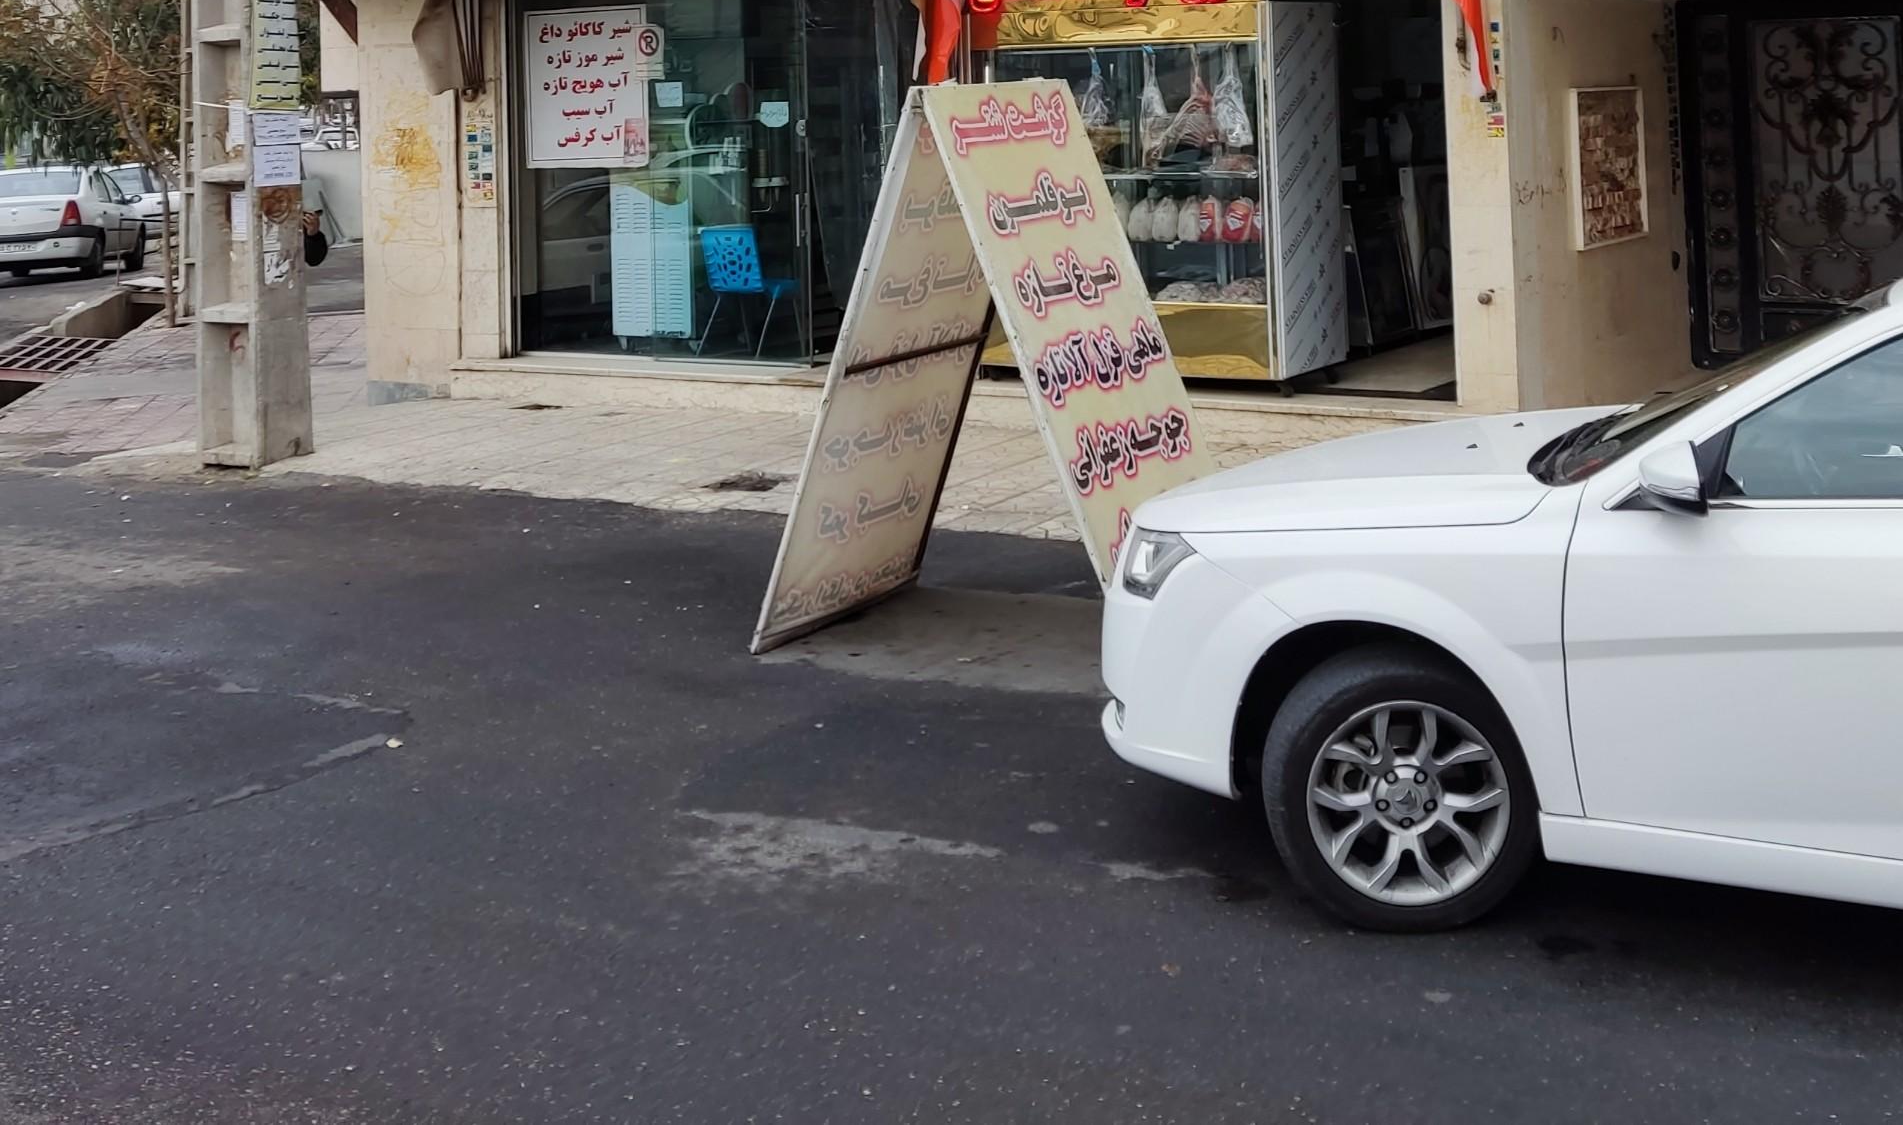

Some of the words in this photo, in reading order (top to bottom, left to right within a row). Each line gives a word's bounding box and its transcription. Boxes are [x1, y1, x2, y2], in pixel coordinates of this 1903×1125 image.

[538, 23, 563, 43] داغ
[565, 21, 605, 42] کاکائو
[608, 19, 632, 40] شیر
[546, 49, 572, 69] تازه
[575, 52, 598, 68] موز
[602, 47, 625, 66] شیر
[543, 76, 568, 95] تازه
[571, 77, 605, 94] هویج
[608, 71, 630, 92] آب
[562, 106, 591, 120] سیب
[594, 99, 615, 119] آب
[1007, 92, 1069, 146] گوشت
[557, 127, 597, 148] کرفس
[601, 125, 622, 146] آب
[951, 100, 1009, 156] شتر
[987, 171, 1094, 236] بوقلمون
[1014, 254, 1075, 317] تازه
[1072, 250, 1121, 304] مرغ
[1089, 328, 1124, 389] قزل
[1124, 318, 1166, 380] ماهی
[1127, 409, 1190, 460] جوجه
